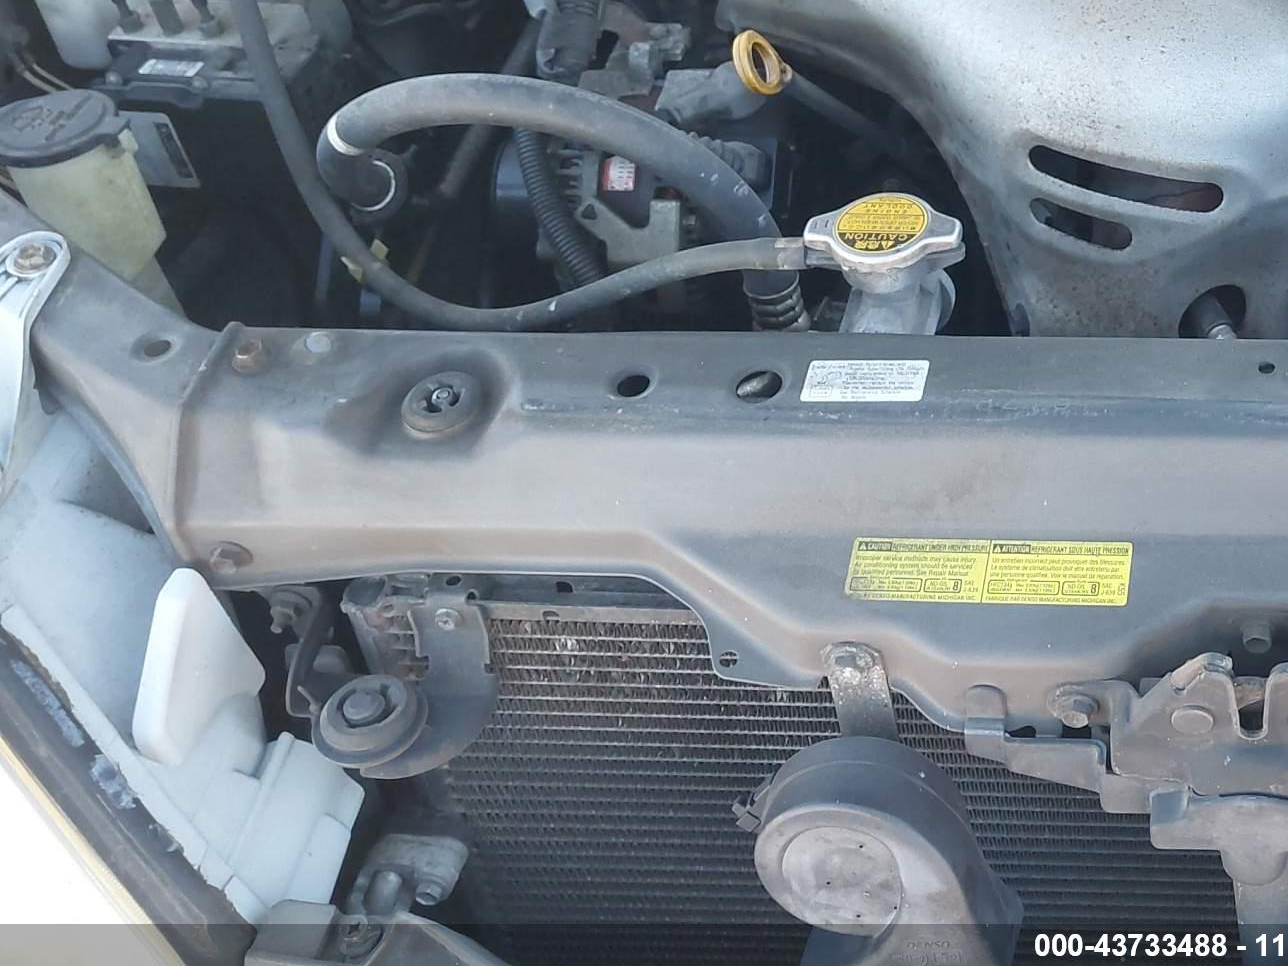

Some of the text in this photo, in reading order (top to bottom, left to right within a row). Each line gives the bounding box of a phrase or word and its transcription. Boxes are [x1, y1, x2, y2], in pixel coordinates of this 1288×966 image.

[844, 233, 908, 241] CAUTION
[952, 581, 959, 591] 8
[1090, 583, 1097, 594] 8
